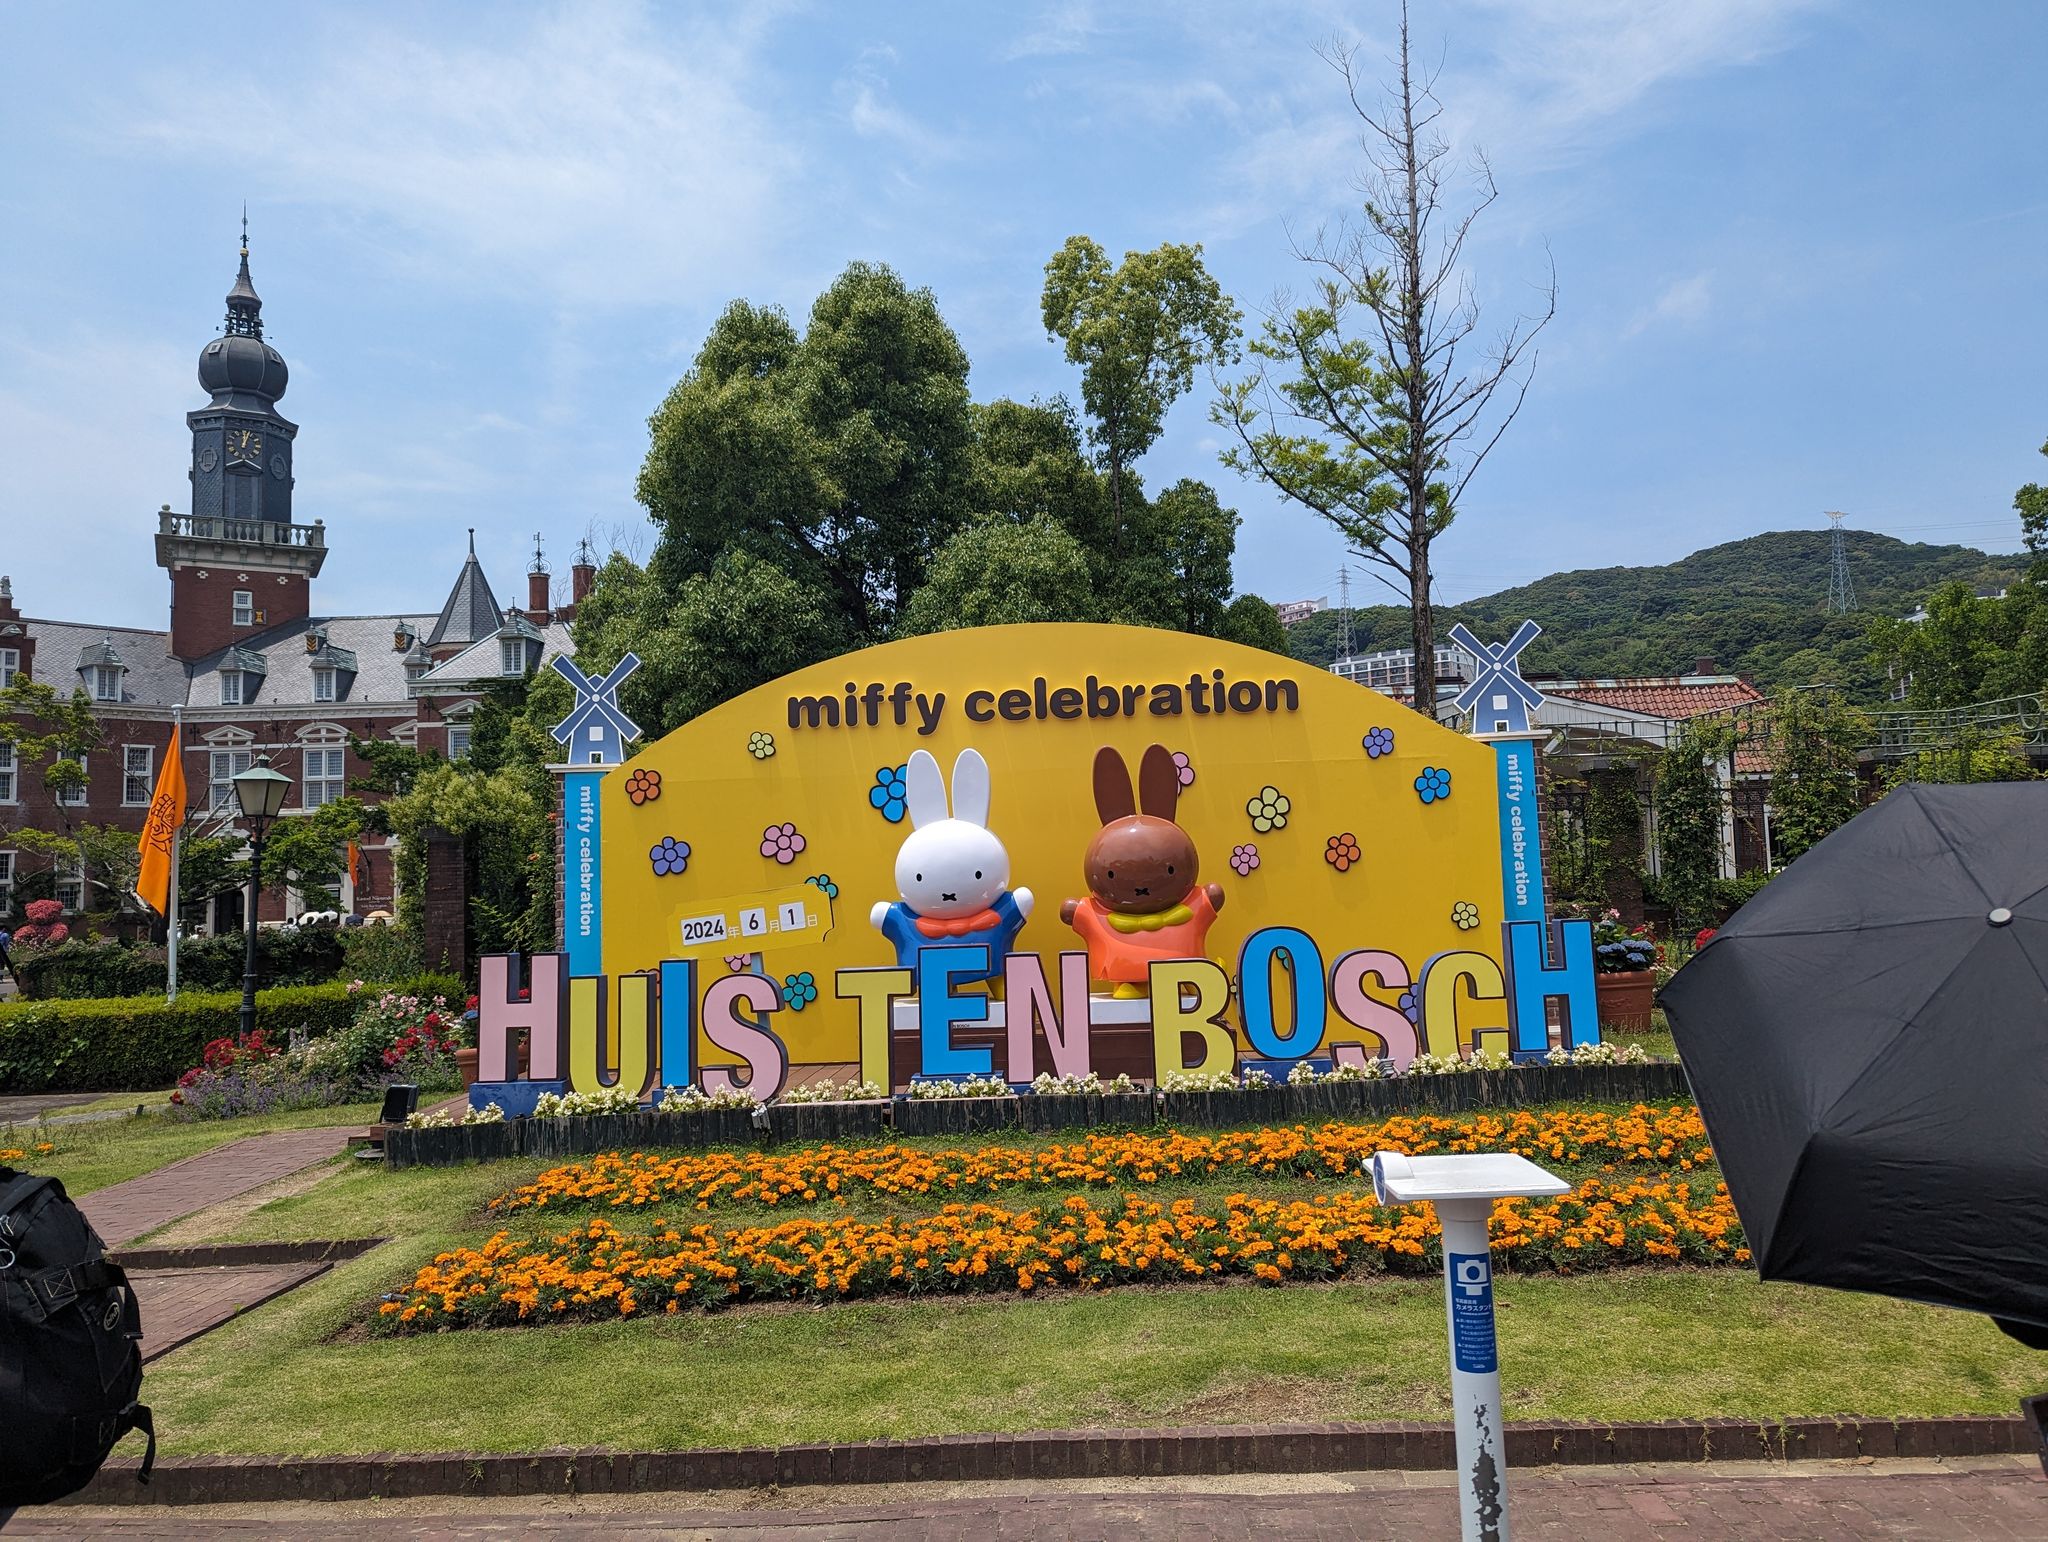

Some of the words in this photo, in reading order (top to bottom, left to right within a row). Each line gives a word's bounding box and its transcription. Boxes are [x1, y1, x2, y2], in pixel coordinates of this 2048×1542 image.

[787, 681, 946, 735] miffy
[963, 668, 1300, 723] celebration
[577, 786, 595, 833] miffy
[1506, 754, 1523, 802] miffy
[580, 837, 595, 936] celebration
[1510, 805, 1530, 906] celebration
[477, 952, 789, 1101] HUIS
[835, 943, 1091, 1097] TEN
[1147, 918, 1602, 1091] BOSCH
